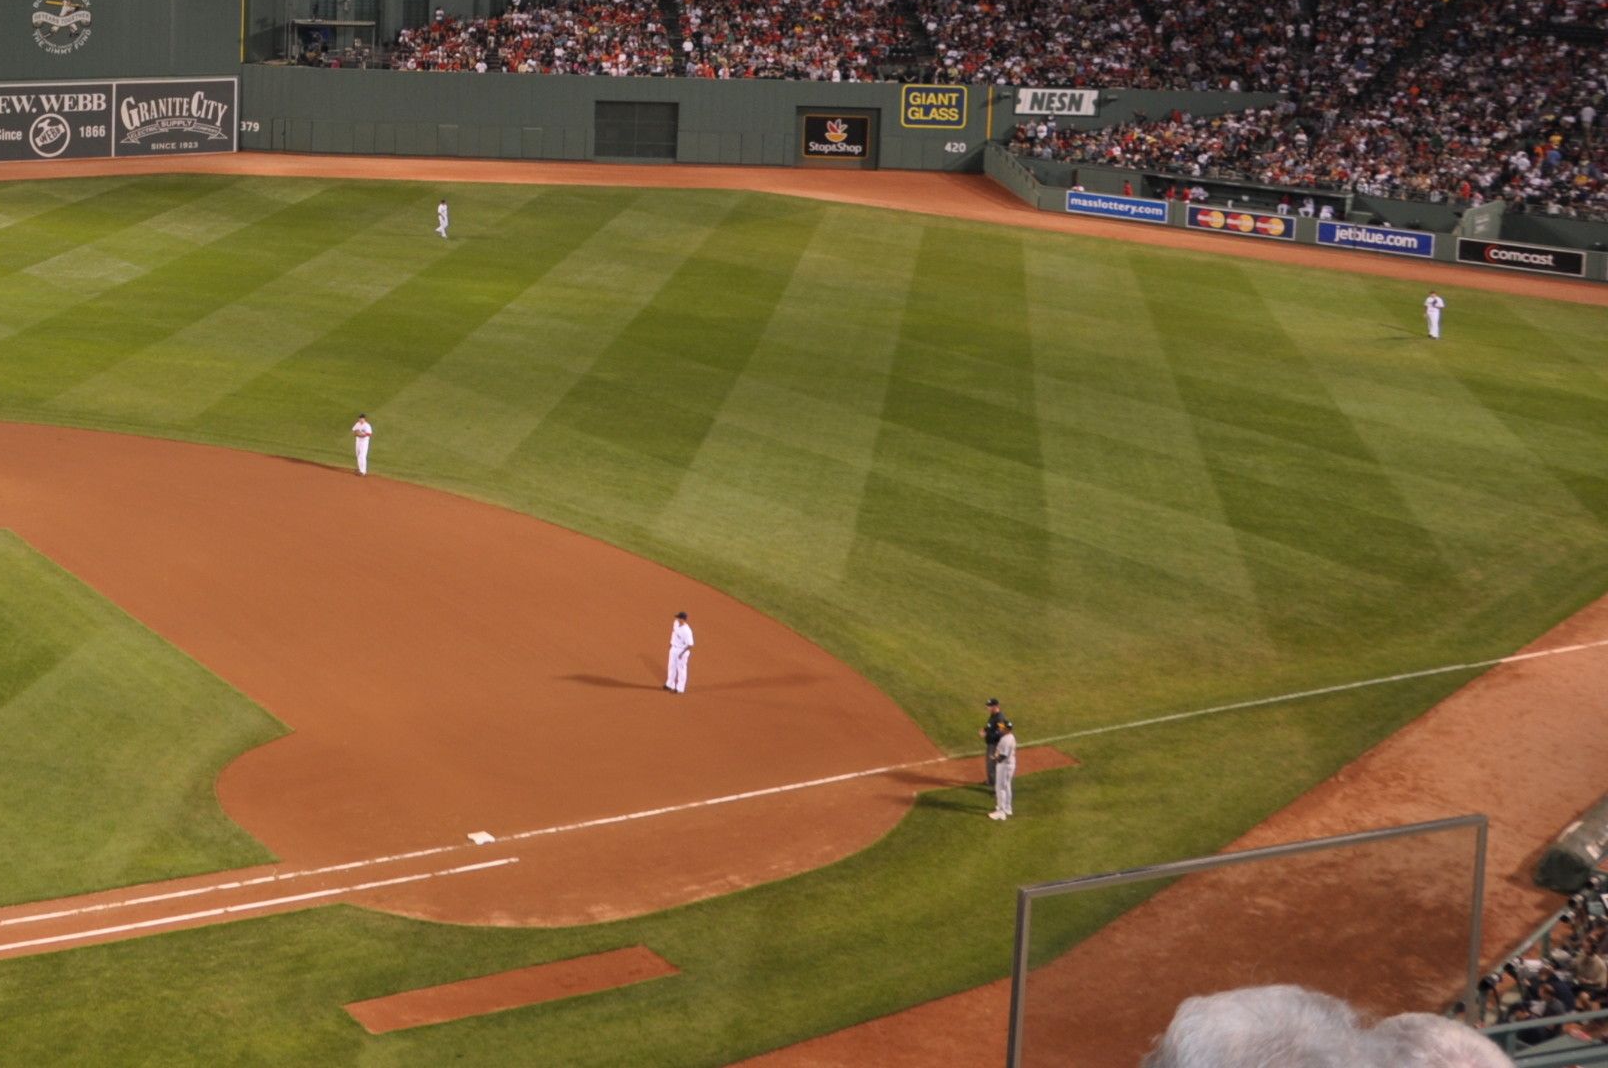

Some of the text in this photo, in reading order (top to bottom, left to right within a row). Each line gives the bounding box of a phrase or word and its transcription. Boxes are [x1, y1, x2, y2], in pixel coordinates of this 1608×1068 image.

[45, 29, 91, 55] JIMMY FUND
[39, 93, 107, 112] WEBB
[909, 92, 959, 106] GIANT
[1029, 92, 1085, 113] NESN
[120, 91, 228, 131] GRANITE CITY
[907, 107, 959, 121] GLASS
[160, 120, 193, 128] SUPPLY
[240, 121, 260, 132] 379
[79, 125, 106, 138] 1866
[150, 141, 199, 150] SINCE 1923
[944, 142, 967, 153] 420
[1070, 196, 1164, 217] masslottery.com
[1489, 247, 1554, 266] comcast
